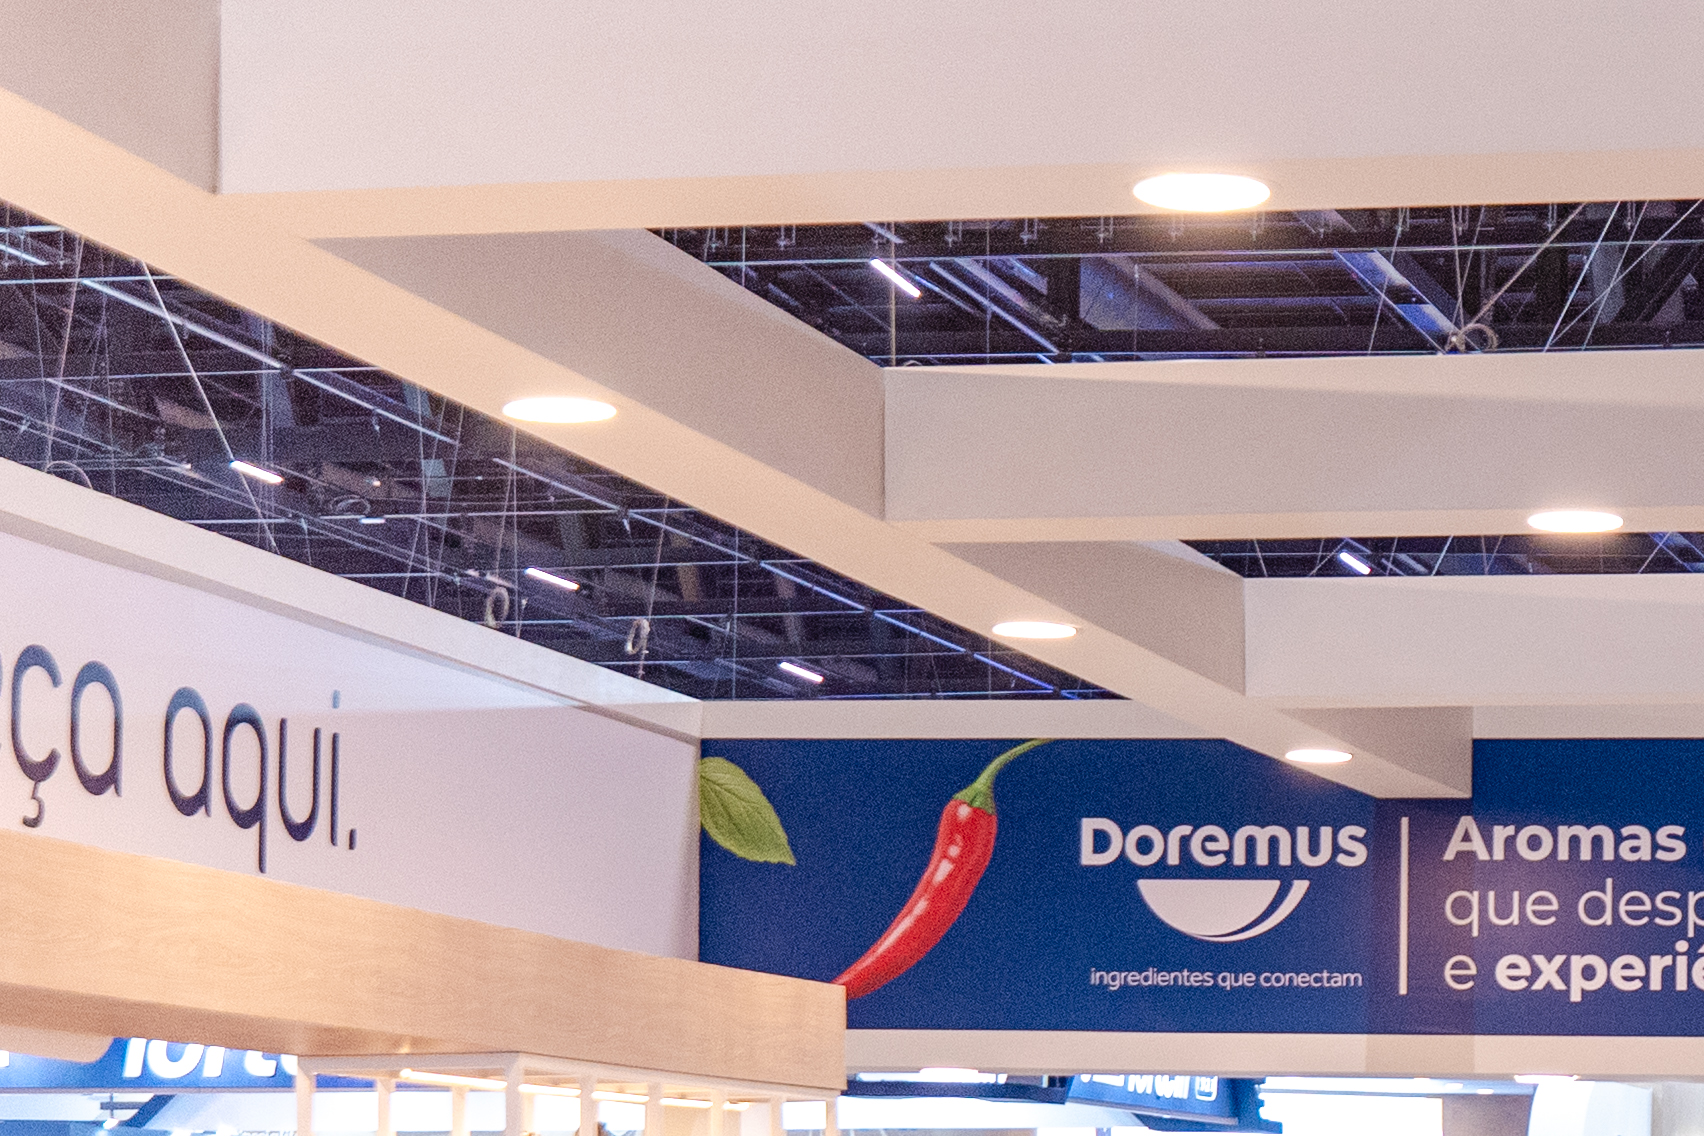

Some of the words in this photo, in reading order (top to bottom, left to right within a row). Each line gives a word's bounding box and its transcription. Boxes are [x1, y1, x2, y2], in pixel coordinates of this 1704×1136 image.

[0, 644, 123, 828] ça
[162, 686, 358, 874] aqui.
[1080, 817, 1368, 867] Doremus
[1443, 816, 1686, 863] Aromas
[1443, 889, 1560, 938] que
[1091, 968, 1214, 991] ingredientes
[1217, 972, 1256, 990] que
[1260, 969, 1362, 988] conectam
[1443, 954, 1478, 991] e
